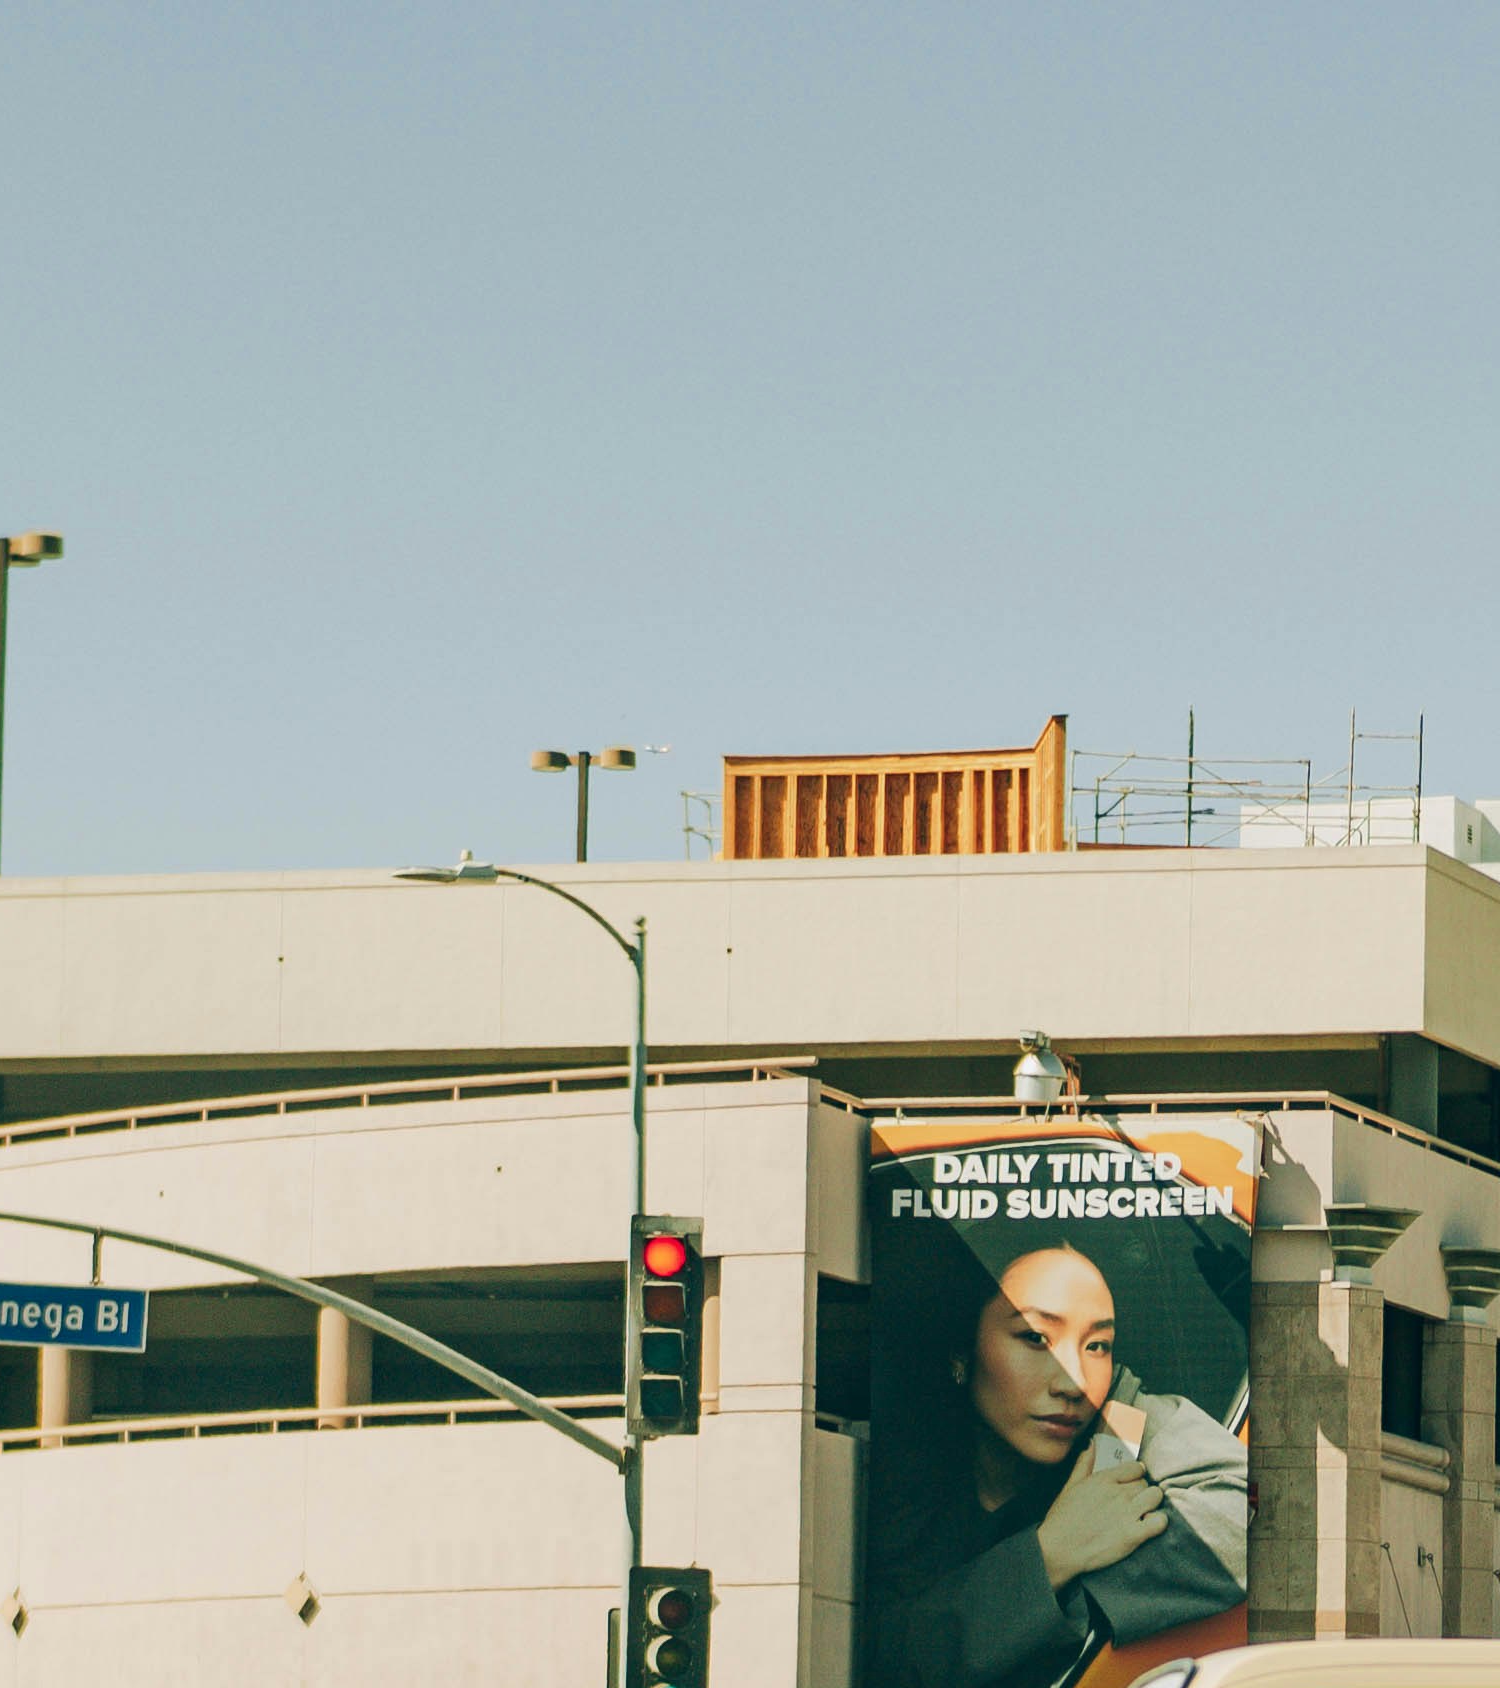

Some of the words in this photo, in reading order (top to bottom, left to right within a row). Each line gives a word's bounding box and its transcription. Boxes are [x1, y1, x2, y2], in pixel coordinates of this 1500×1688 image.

[932, 1152, 1040, 1185] DAILY
[1046, 1152, 1182, 1183] TINTED
[891, 1188, 999, 1220] FLUID
[1006, 1185, 1235, 1220] SUNSCREEN
[96, 1299, 130, 1334] Bl
